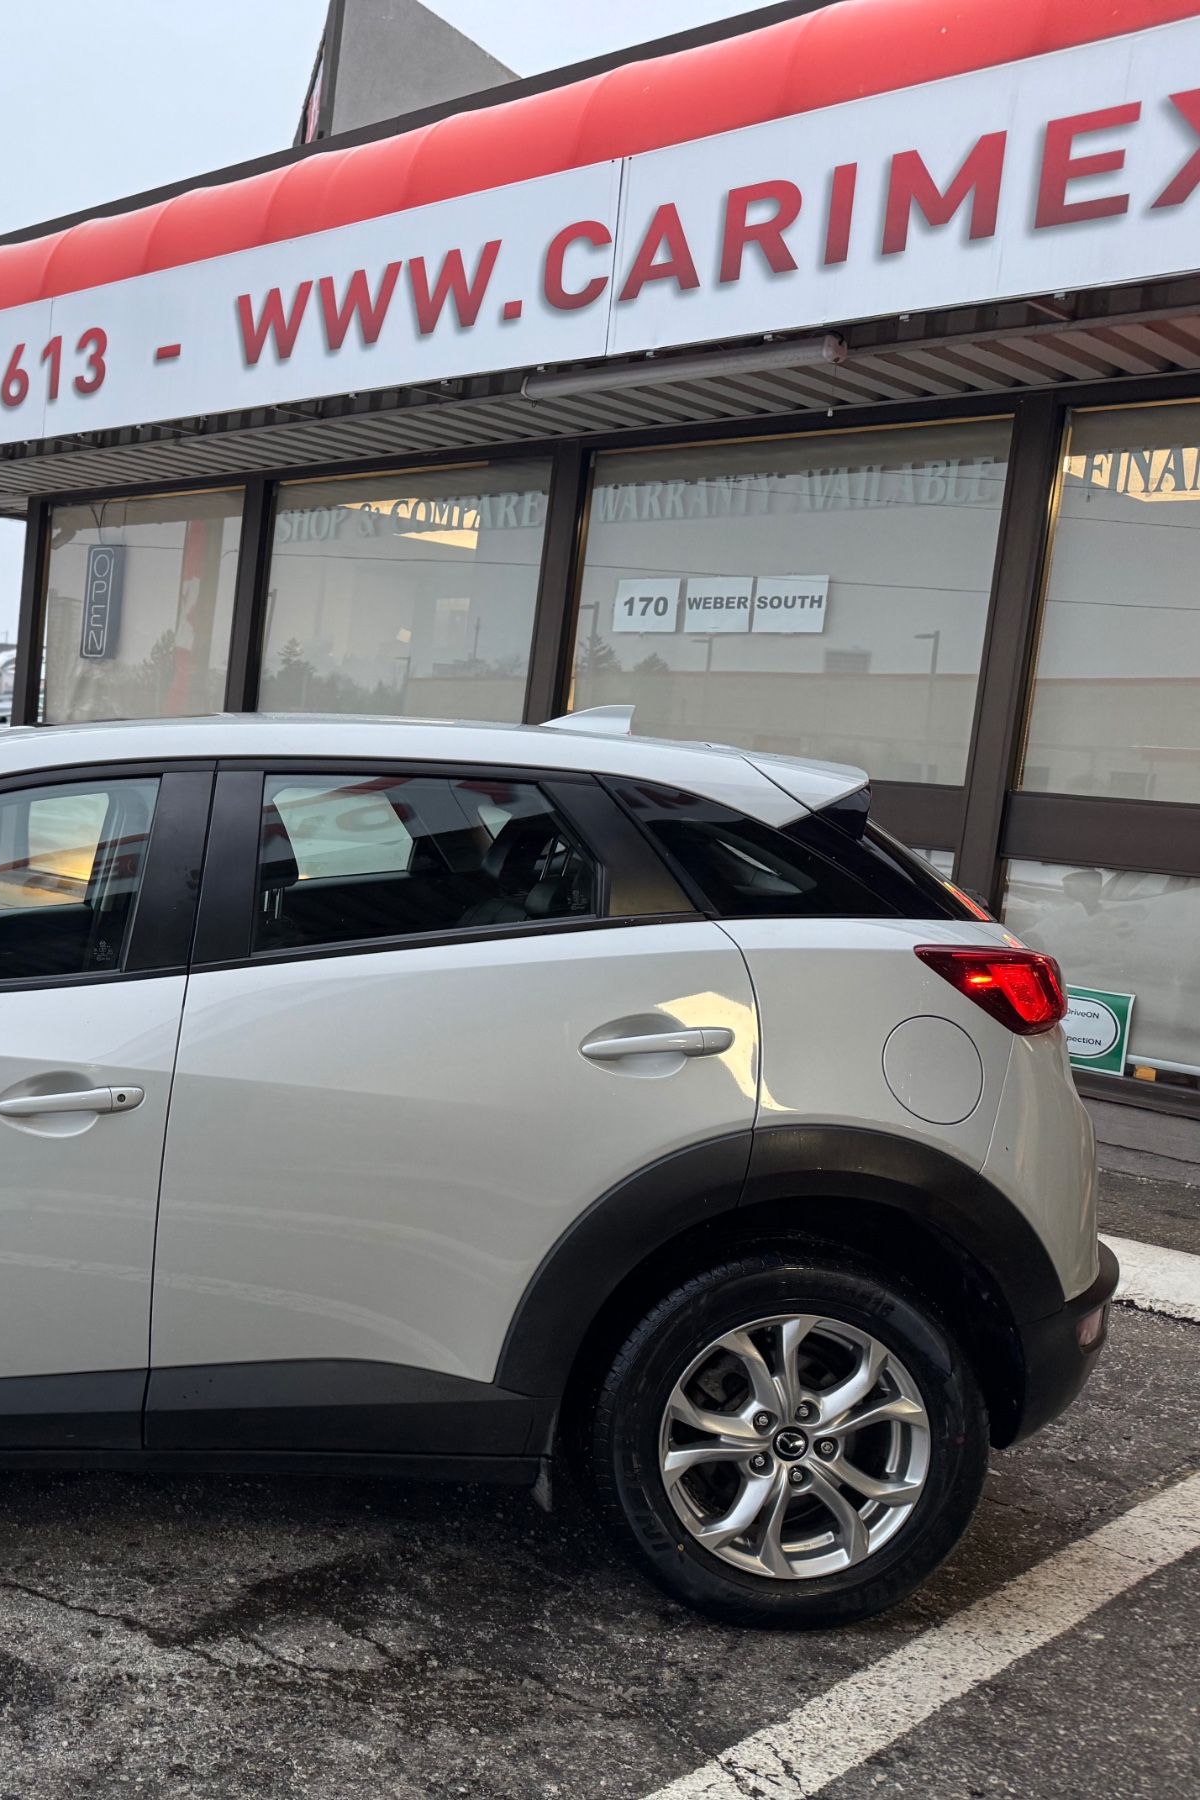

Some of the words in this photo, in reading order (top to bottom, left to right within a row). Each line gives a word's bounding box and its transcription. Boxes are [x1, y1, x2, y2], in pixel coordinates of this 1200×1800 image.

[599, 472, 785, 522] WARRANTY
[800, 456, 997, 512] AVAILABLE
[275, 506, 349, 544] SHOP
[359, 503, 382, 538] &
[388, 490, 545, 534] COMPARE
[87, 553, 112, 653] OPEN
[623, 596, 669, 618] 170
[686, 595, 749, 611] WEBER
[756, 594, 823, 610] SOUTH
[1066, 1035, 1102, 1046] pectiON
